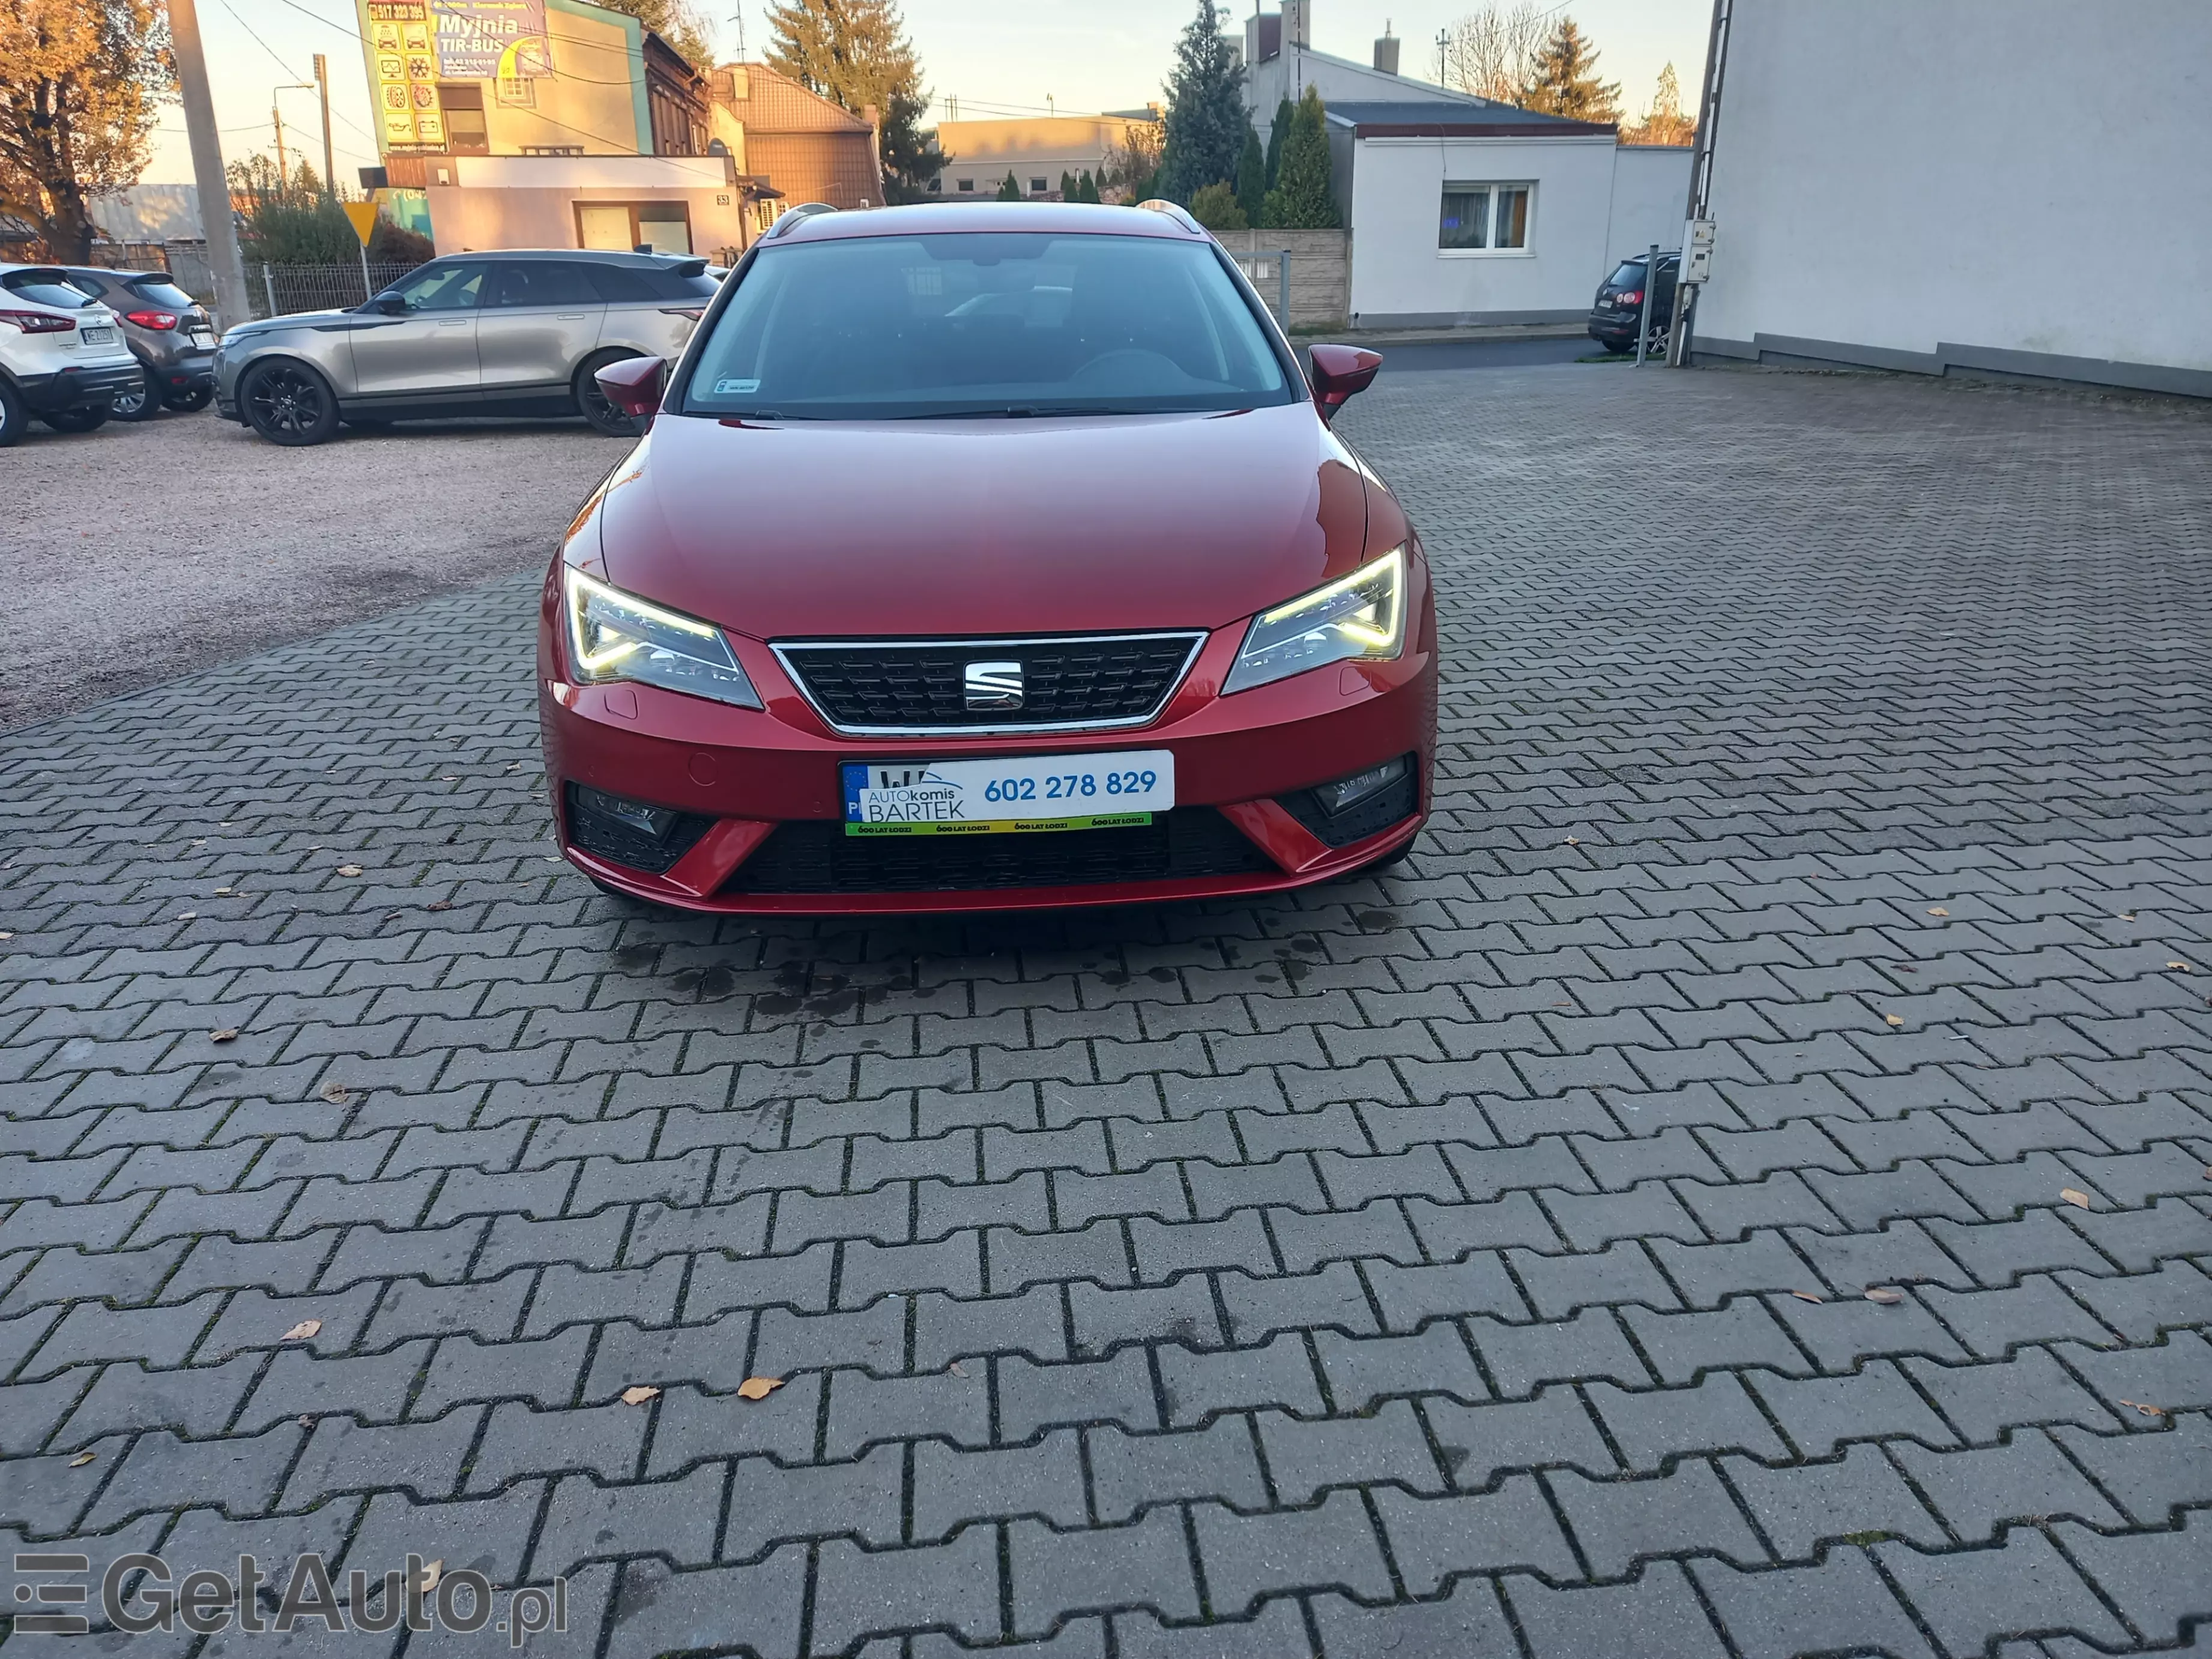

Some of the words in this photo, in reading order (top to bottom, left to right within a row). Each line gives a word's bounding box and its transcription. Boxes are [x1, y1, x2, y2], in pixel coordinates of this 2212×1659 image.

[378, 4, 392, 19] 517
[440, 14, 518, 38] Myjnia
[441, 38, 504, 53] TIR-BUS
[985, 779, 1036, 802] 602
[1045, 774, 1096, 799] 278
[1106, 770, 1157, 794] 829
[869, 788, 955, 803] AUTOkomis
[869, 800, 965, 823] BARTEK
[1092, 818, 1108, 826] 600
